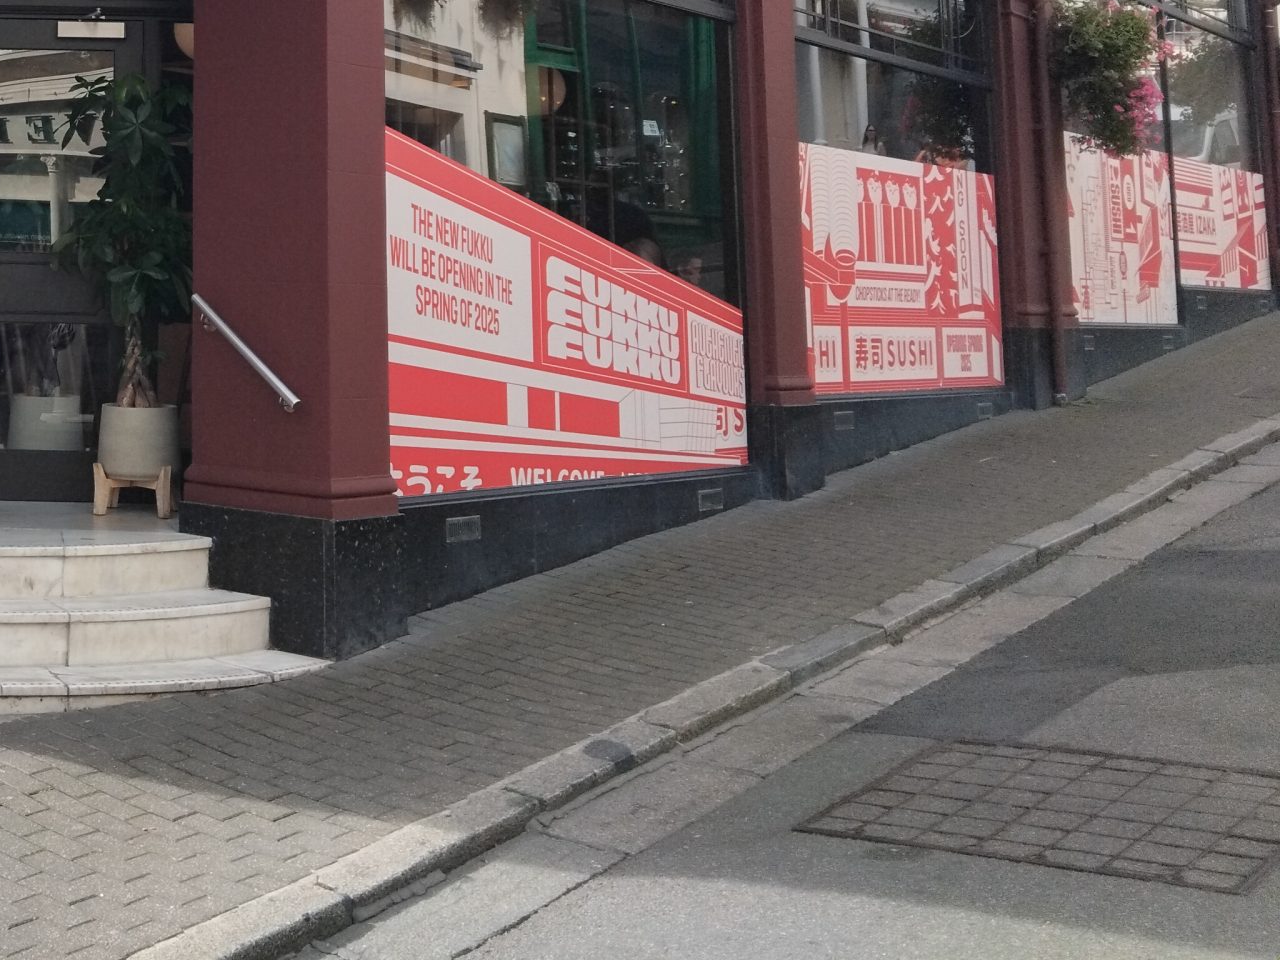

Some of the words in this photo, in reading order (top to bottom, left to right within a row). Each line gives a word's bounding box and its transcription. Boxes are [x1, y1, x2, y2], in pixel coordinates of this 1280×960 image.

[411, 203, 433, 240] THE
[435, 214, 459, 250] NEW
[461, 225, 493, 264] FUKKU
[1111, 183, 1122, 234] SUSHI
[389, 234, 419, 274] WILL
[421, 246, 436, 280] BE
[438, 253, 483, 295] OPENING
[485, 270, 494, 299] IN
[495, 274, 513, 305] THE
[958, 220, 969, 289] SOON
[415, 284, 458, 325] SPRING
[460, 298, 473, 328] OF
[474, 303, 500, 336] 2025
[546, 255, 679, 335] FUKKU
[855, 286, 887, 301] CHOPSTICKS
[546, 289, 680, 360] FUKKU
[547, 323, 681, 385] FUKKU
[855, 336, 884, 370] 寿司
[887, 339, 933, 368] SUSHI
